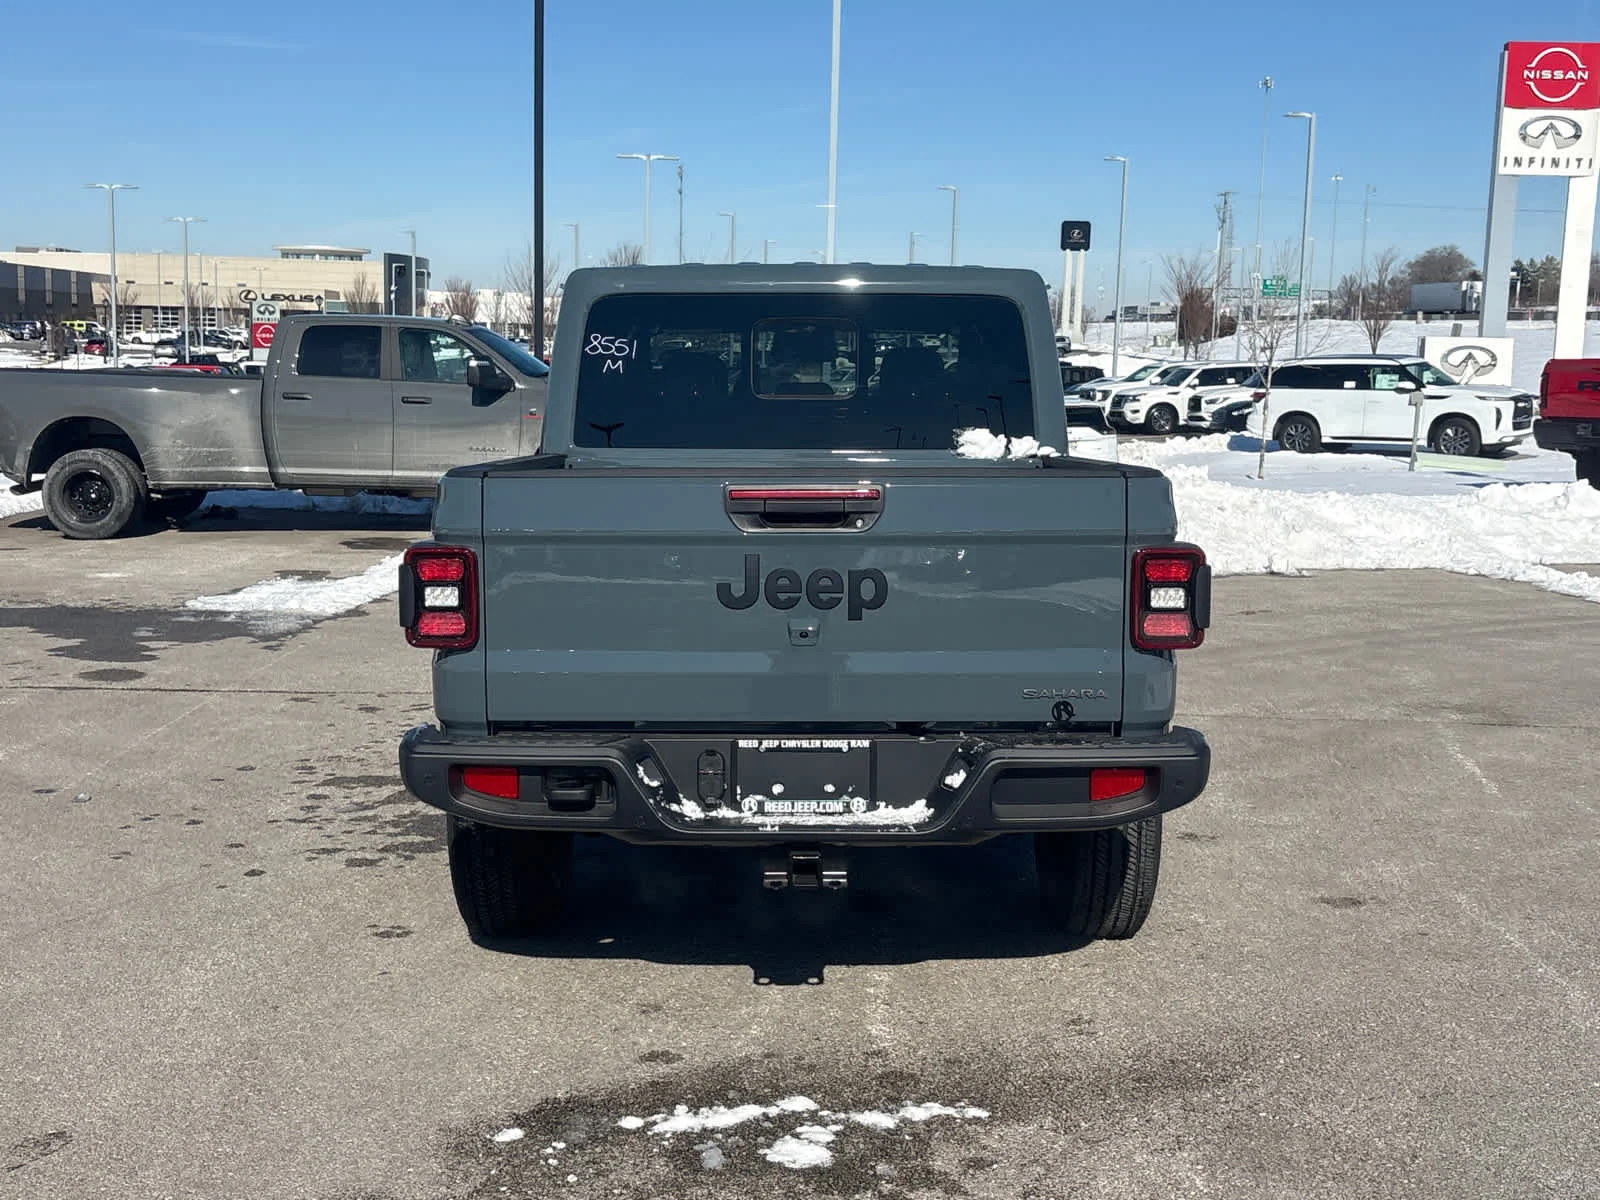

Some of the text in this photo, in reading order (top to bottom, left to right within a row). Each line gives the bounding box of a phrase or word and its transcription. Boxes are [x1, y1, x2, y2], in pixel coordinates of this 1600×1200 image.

[1523, 69, 1588, 80] NISSAN
[1503, 156, 1593, 169] INFINITI
[261, 293, 314, 302] LEXUS
[584, 333, 638, 360] 8551
[602, 359, 623, 374] M
[716, 553, 888, 621] Jeep
[1023, 687, 1107, 699] SAHARA
[738, 739, 870, 748] REED JEEP CHRYSLER DODGE RAM
[764, 800, 843, 813] REEDJEEP.COM
